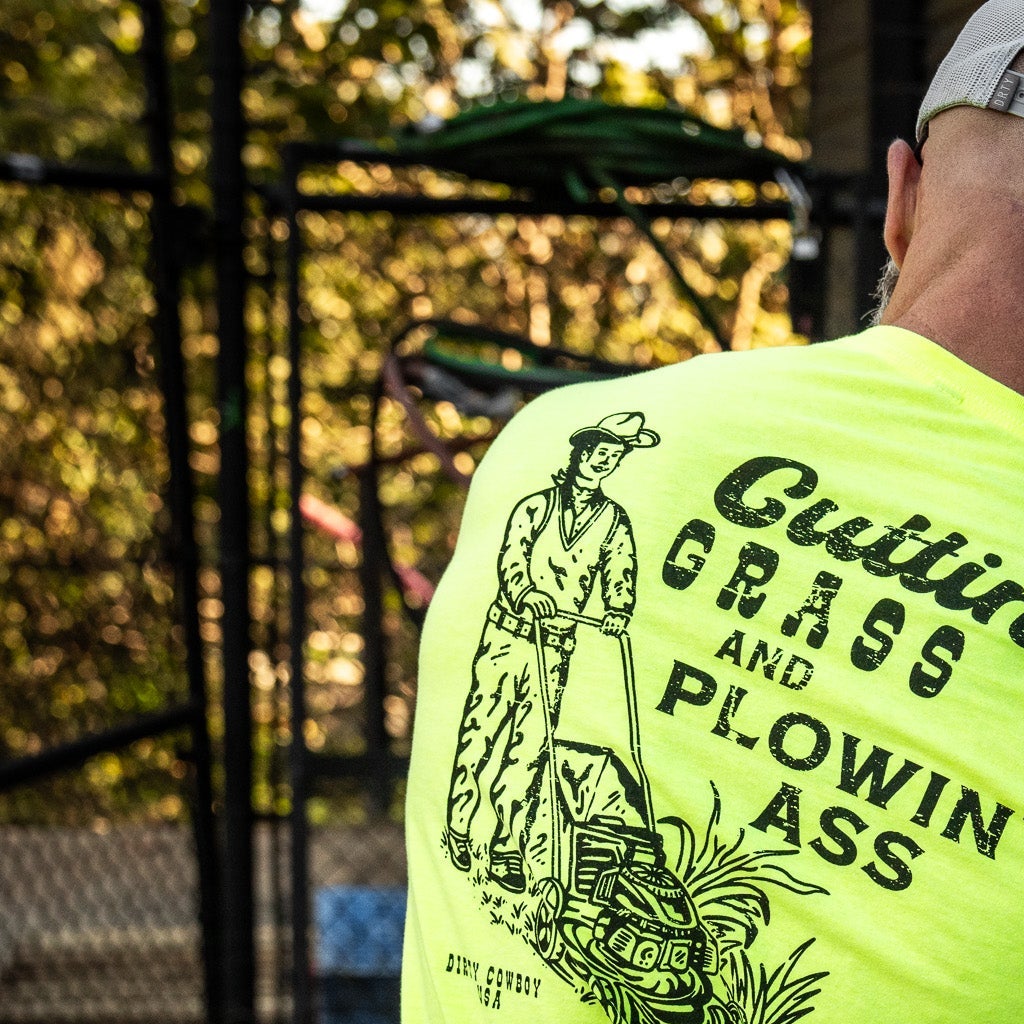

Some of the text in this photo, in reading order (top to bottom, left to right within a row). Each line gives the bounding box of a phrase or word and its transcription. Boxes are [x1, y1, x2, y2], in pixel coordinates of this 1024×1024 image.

[994, 77, 1014, 107] DRTY
[661, 518, 966, 699] GRASS
[713, 629, 815, 691] AND
[748, 781, 926, 892] ASS
[486, 966, 542, 998] COWBOY
